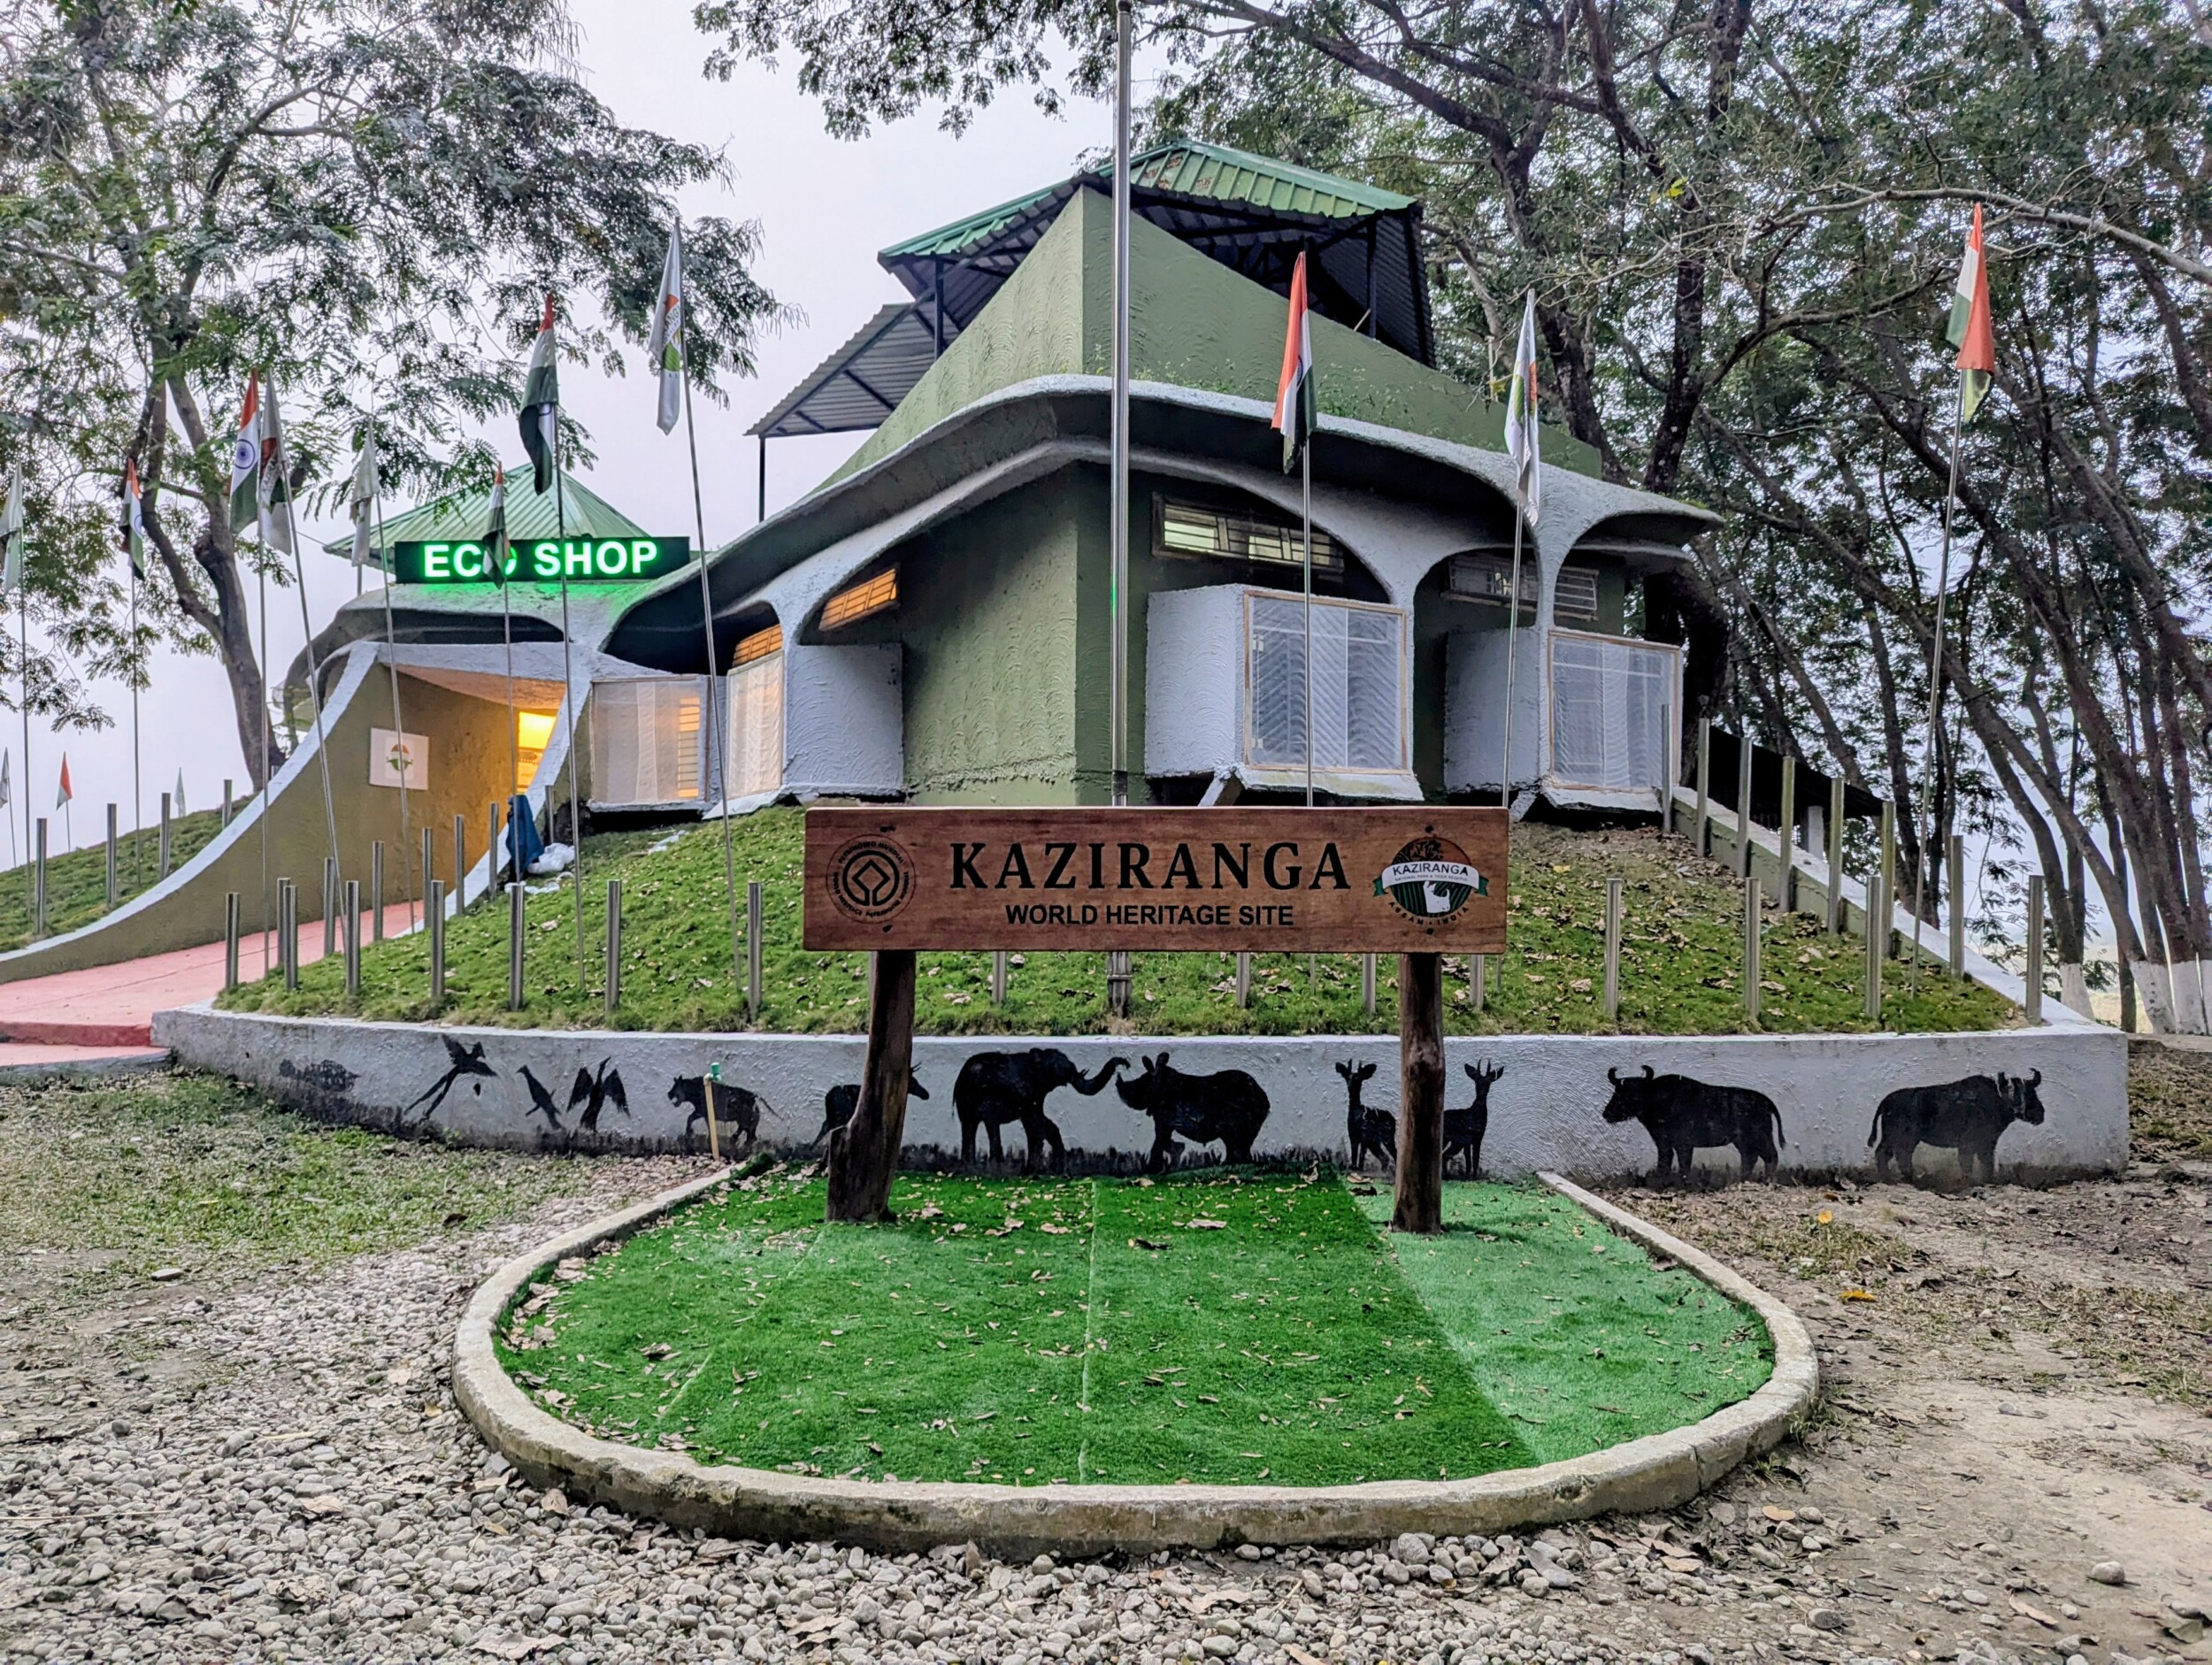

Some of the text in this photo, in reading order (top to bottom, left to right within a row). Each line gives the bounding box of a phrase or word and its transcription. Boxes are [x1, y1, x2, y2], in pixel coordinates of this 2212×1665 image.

[534, 541, 657, 576] SHOP
[950, 842, 1351, 890] KAZIRANGA
[1393, 863, 1469, 877] KAZIRANGA
[1005, 904, 1294, 926] WORLD HERITAGE SITE
